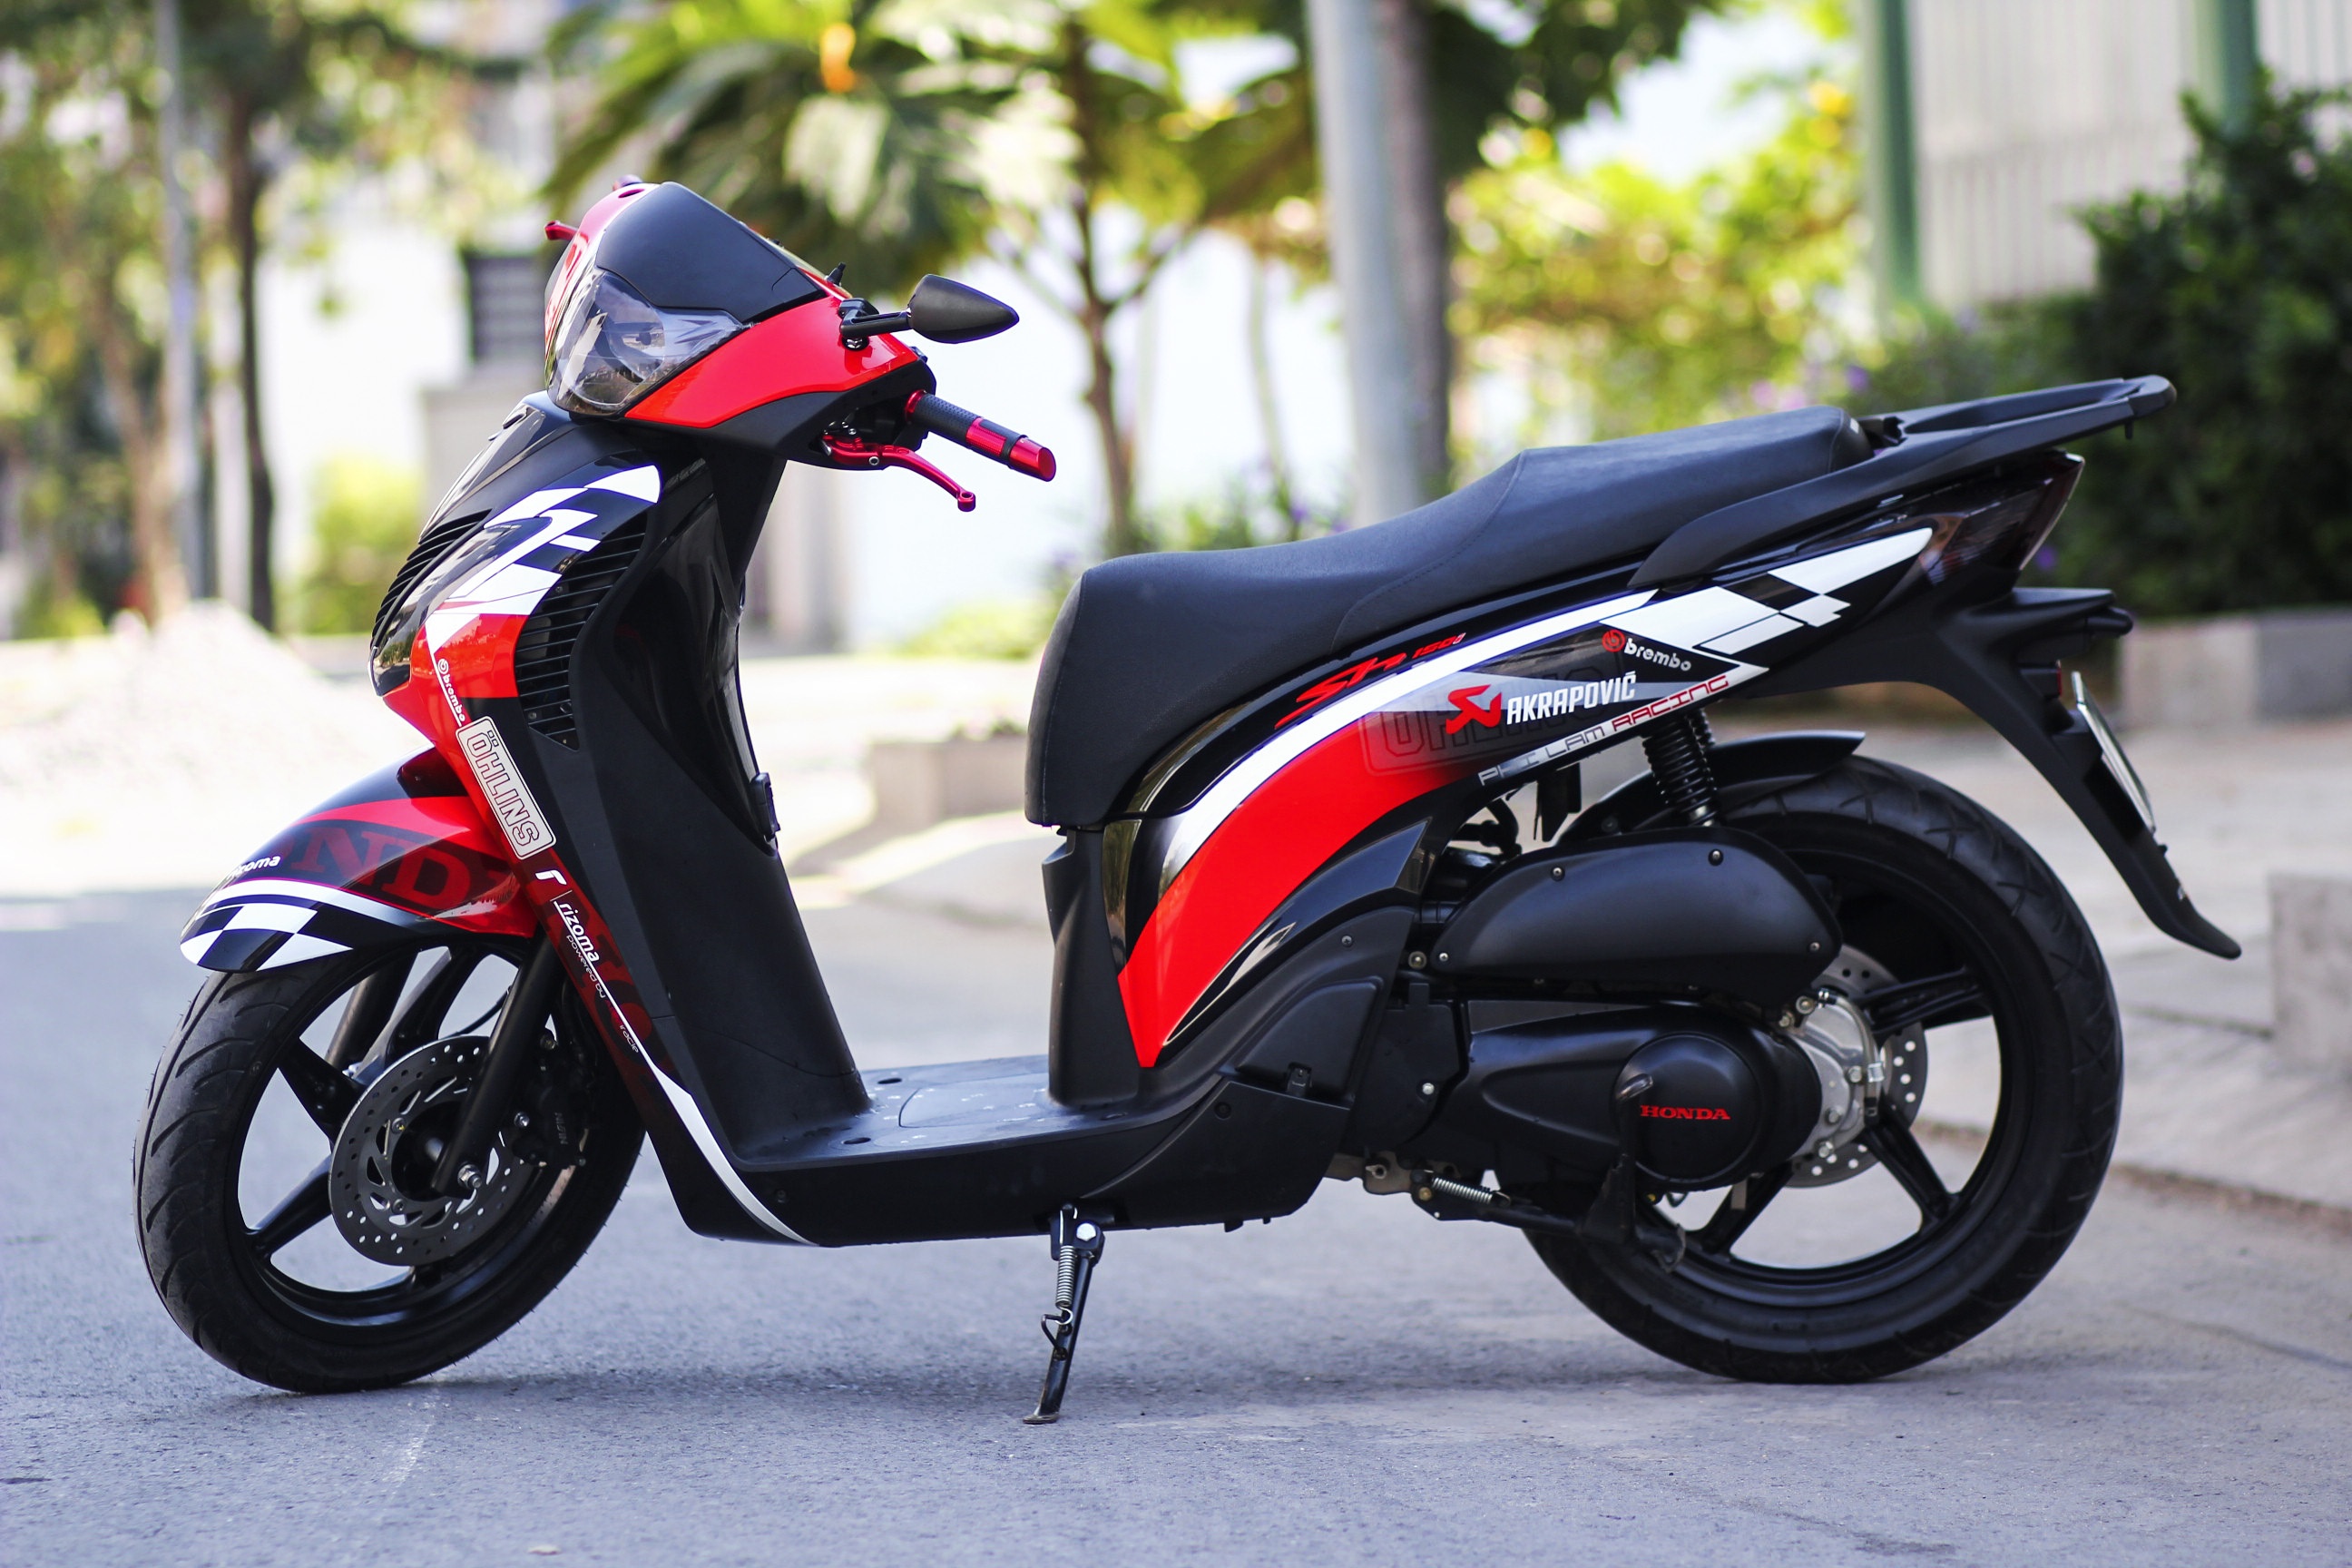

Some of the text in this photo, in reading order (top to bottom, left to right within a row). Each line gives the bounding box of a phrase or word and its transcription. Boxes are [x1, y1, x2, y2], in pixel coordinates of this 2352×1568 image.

[1624, 637, 1692, 671] brembo
[443, 673, 466, 722] brembo
[1545, 725, 1605, 759] LAM
[1612, 674, 1730, 732] RACING
[466, 730, 540, 848] ÖHLINS
[559, 902, 600, 963] rizoma
[566, 934, 597, 983] powered
[595, 983, 607, 999] by
[1640, 1104, 1731, 1120] HONDA
